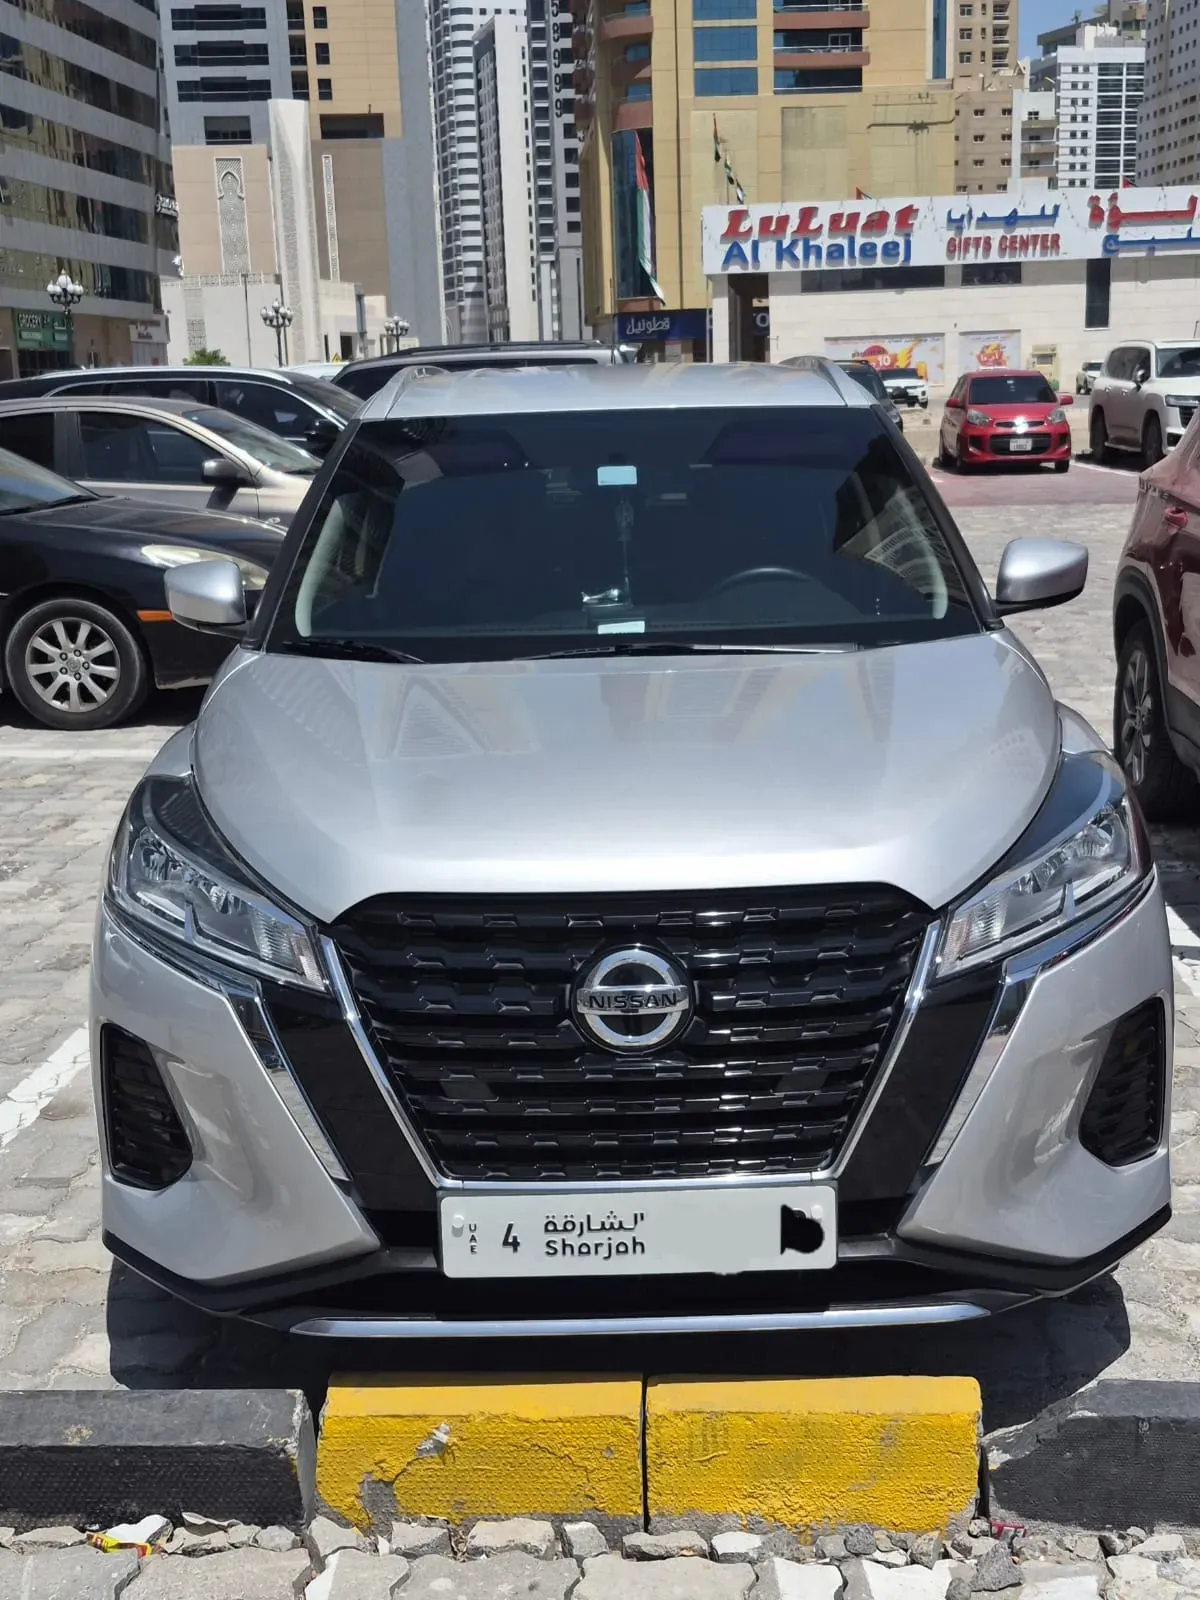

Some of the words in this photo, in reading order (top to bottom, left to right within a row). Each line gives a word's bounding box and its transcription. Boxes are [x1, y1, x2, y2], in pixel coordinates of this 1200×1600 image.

[722, 204, 919, 240] LuLuat
[721, 238, 760, 268] Al
[775, 233, 912, 266] Khaleej
[947, 236, 992, 256] GIFTS
[999, 233, 1061, 253] CENTER
[588, 993, 677, 1009] NISSAN
[502, 1223, 521, 1254] 4
[545, 1237, 646, 1260] Sharjah
